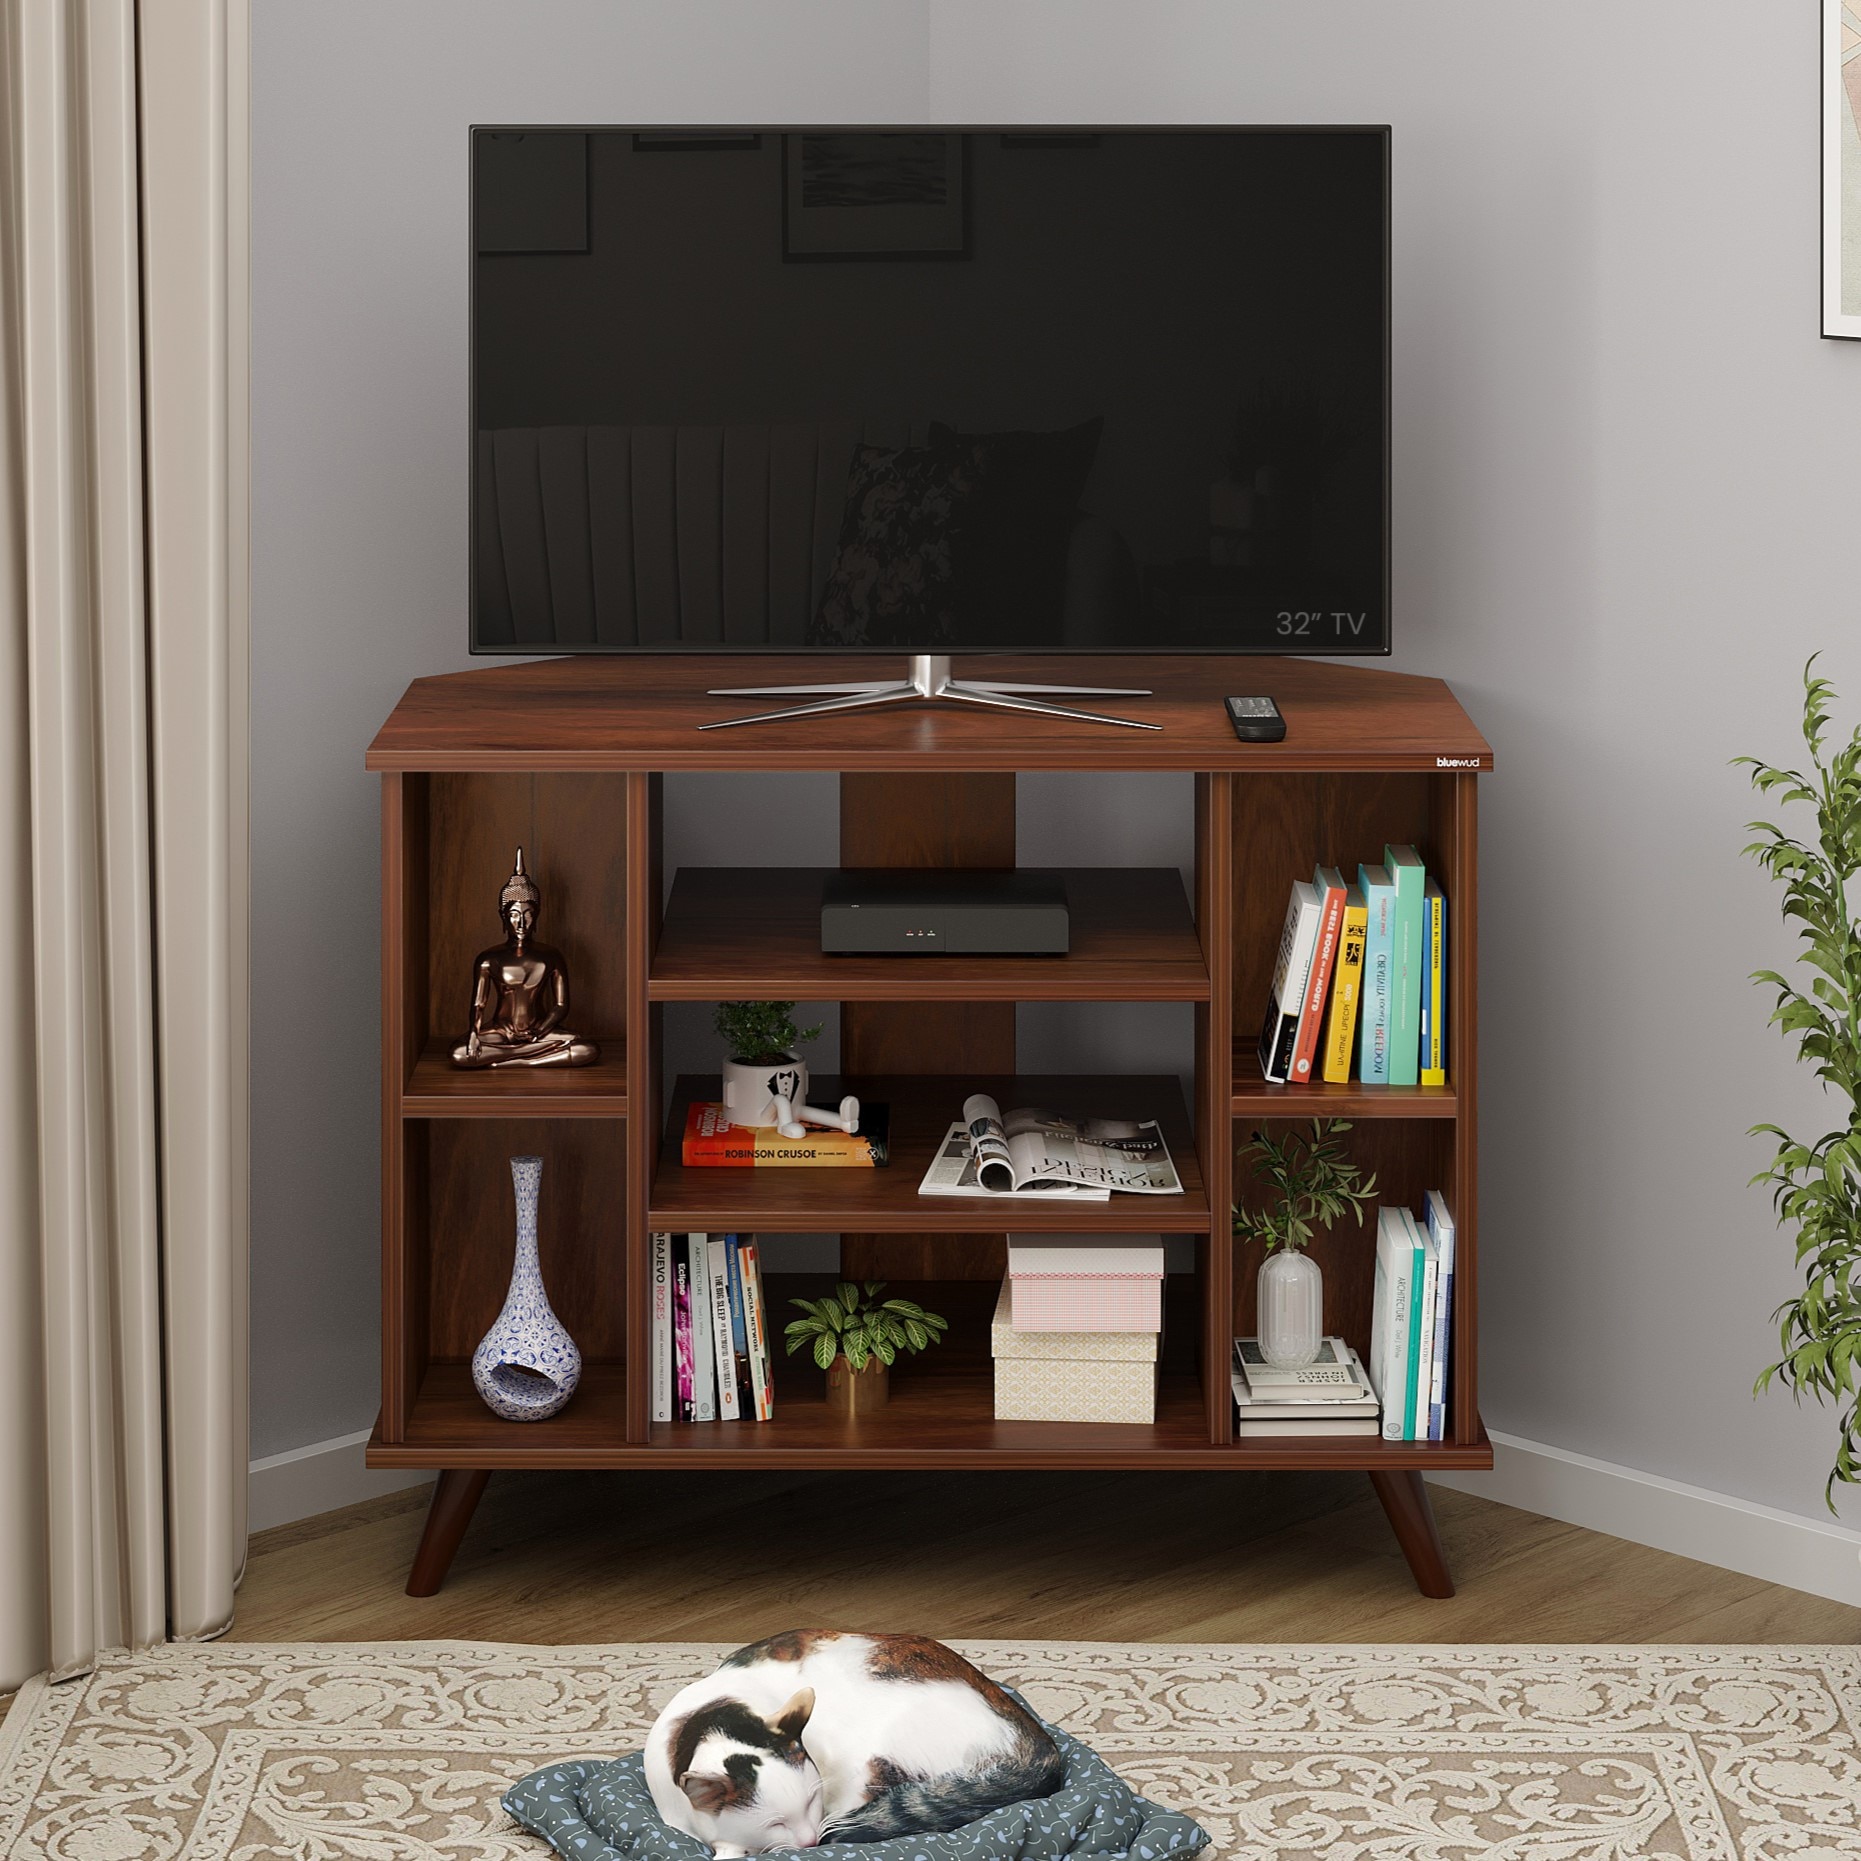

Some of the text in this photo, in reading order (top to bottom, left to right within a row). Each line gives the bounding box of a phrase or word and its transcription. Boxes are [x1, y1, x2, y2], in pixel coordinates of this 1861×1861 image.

[1330, 612, 1366, 635] TV
[1435, 756, 1480, 767] bluewud
[700, 1107, 718, 1137] ROBINSON
[716, 1111, 730, 1133] CRUS
[725, 1150, 775, 1159] ROBINSON
[777, 1150, 817, 1159] CRUSOE
[695, 1246, 703, 1297] ARCHITECTURE
[714, 1274, 723, 1287] THE
[656, 1285, 666, 1320] ROSES
[716, 1287, 724, 1299] BIG
[746, 1286, 755, 1315] SOCIAL
[1395, 1276, 1406, 1322] ARCHITECTURE
[717, 1300, 726, 1321] SLEEP
[719, 1328, 729, 1357] RAYMOND
[749, 1317, 759, 1353] NETWORK
[1422, 1329, 1430, 1364] NAVIGATION
